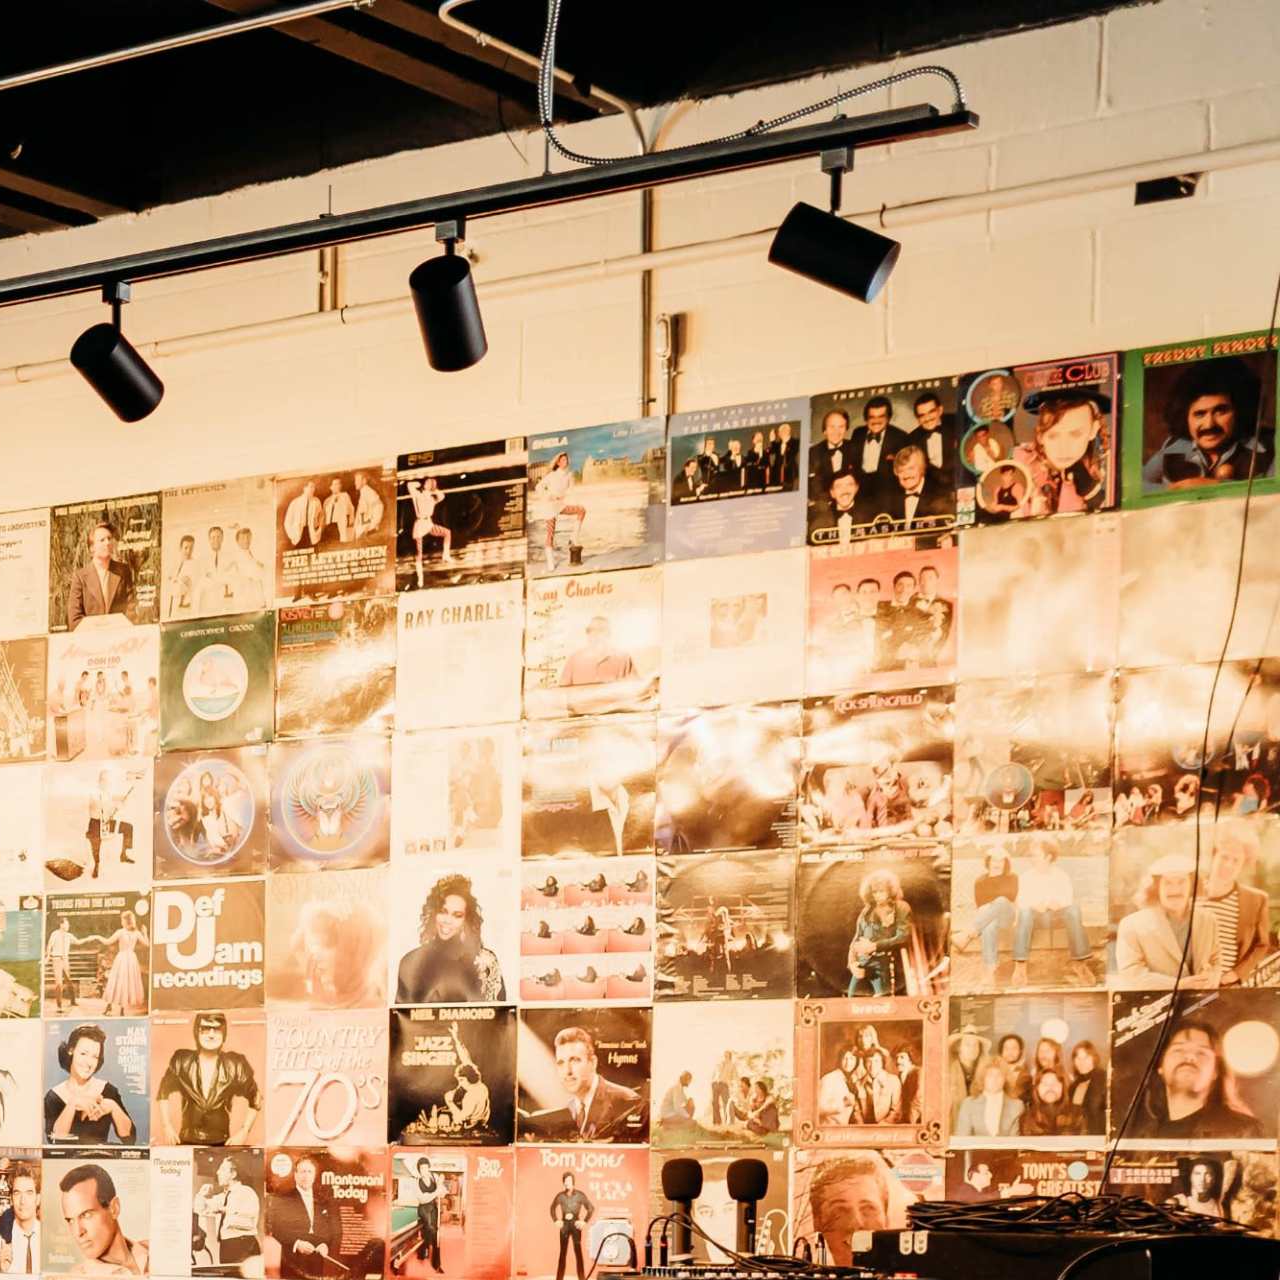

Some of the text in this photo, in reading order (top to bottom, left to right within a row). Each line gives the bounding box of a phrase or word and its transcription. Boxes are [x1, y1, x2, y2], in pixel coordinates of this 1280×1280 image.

[1066, 360, 1110, 382] CLUB
[833, 380, 941, 401] THRU THE YEARS
[282, 545, 388, 570] THE LETTERMEN
[223, 582, 234, 598] L
[566, 579, 614, 599] Charles
[404, 608, 434, 630] RAY
[153, 966, 264, 991] recordings
[438, 1008, 496, 1020] DIAMOND
[414, 1036, 454, 1051] JAZZ
[540, 1149, 625, 1172] Tom Jones
[321, 1170, 385, 1186] Mantovani
[1021, 1162, 1068, 1181] TONY'S
[332, 1184, 368, 1203] Today
